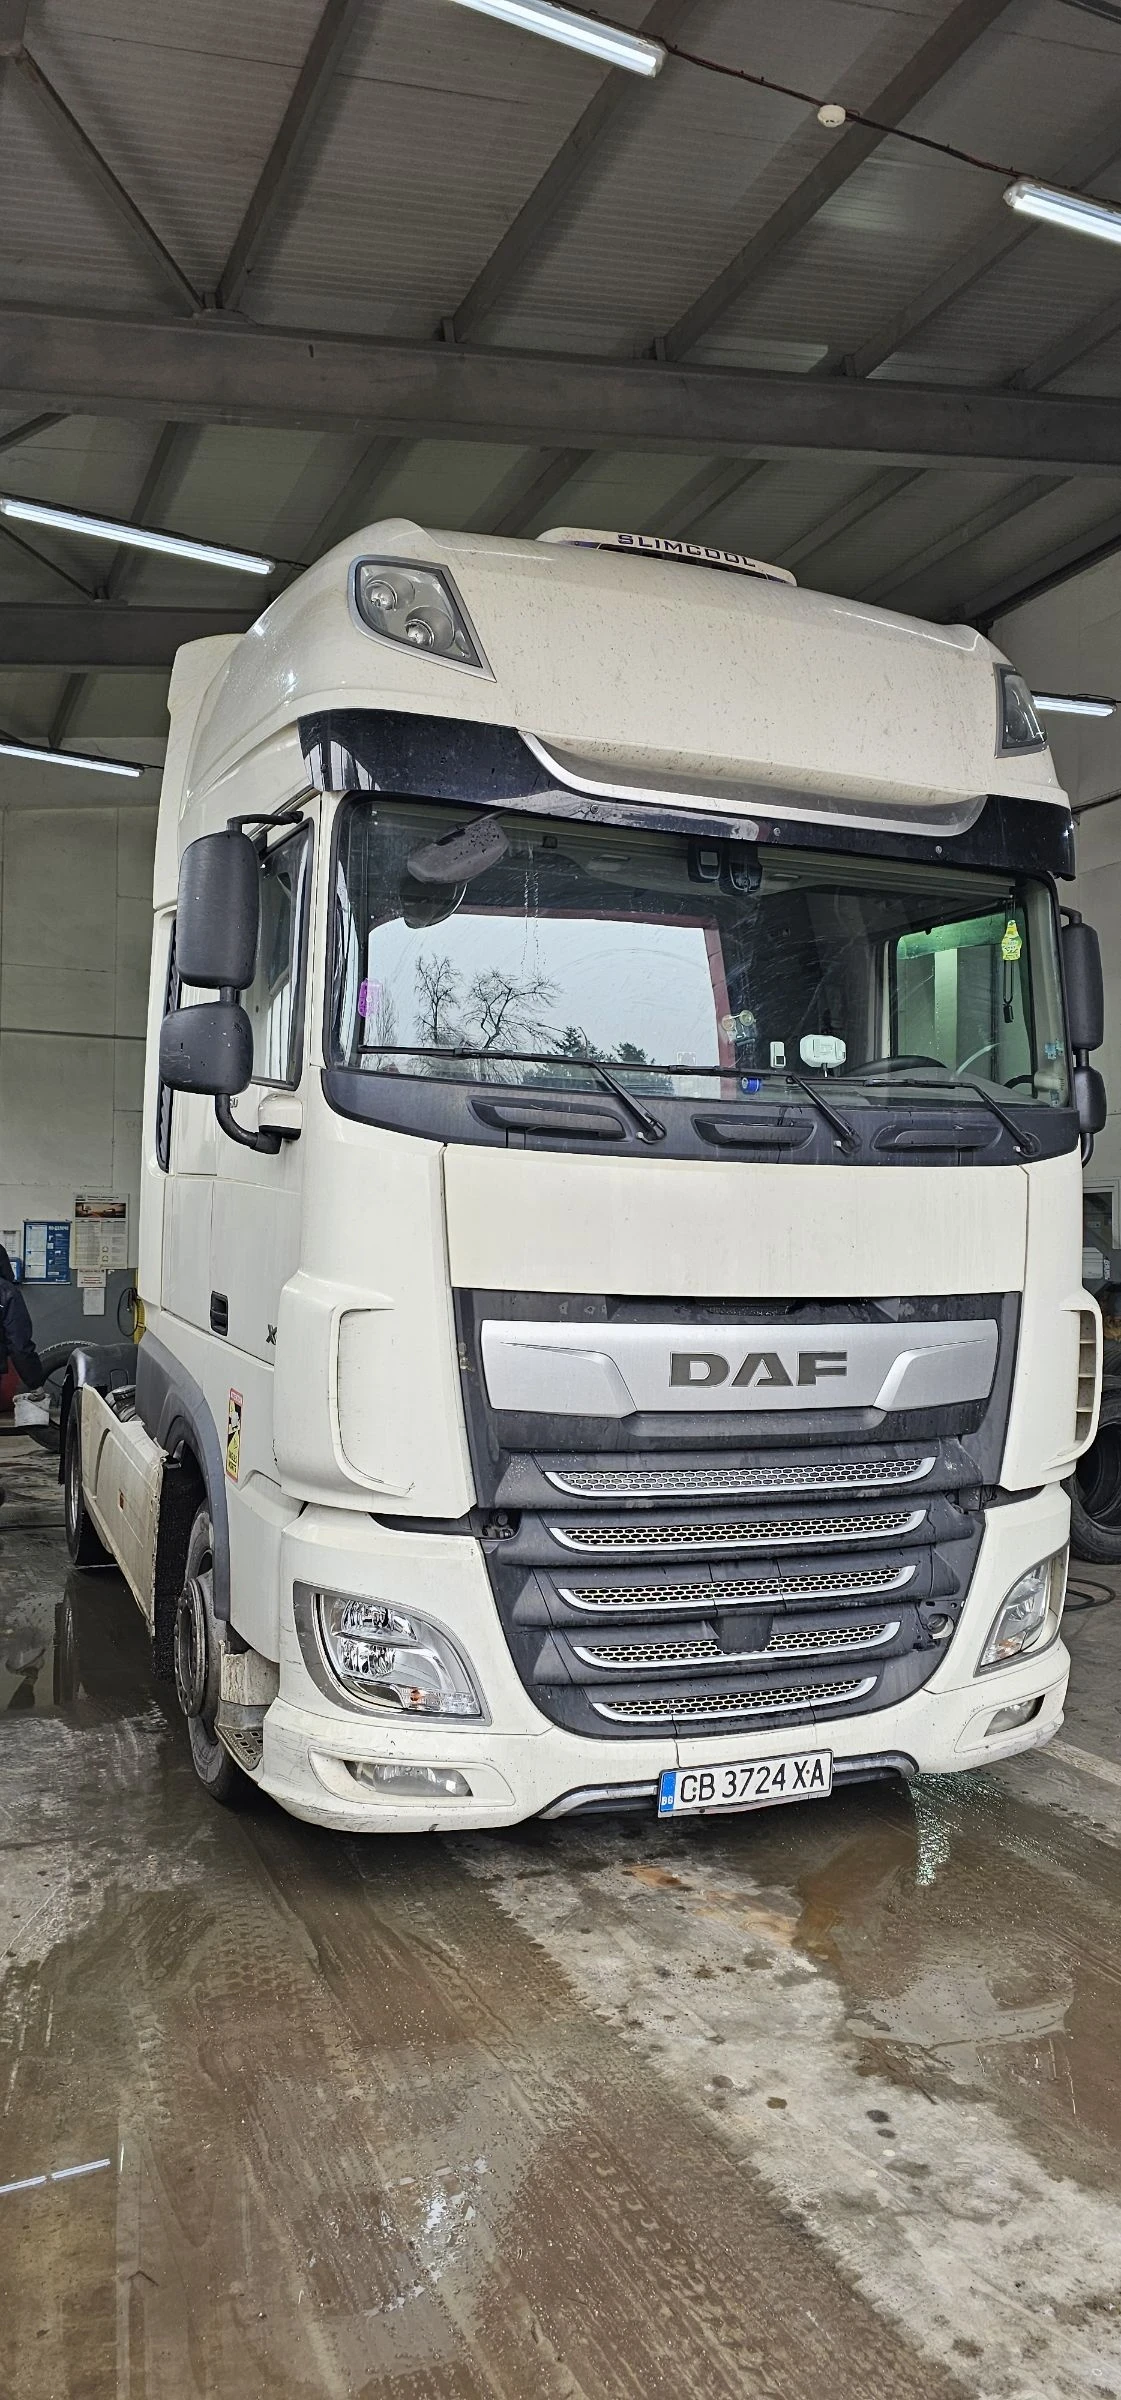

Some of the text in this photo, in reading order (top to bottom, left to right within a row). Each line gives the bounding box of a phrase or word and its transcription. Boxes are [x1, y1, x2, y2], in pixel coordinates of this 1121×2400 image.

[618, 534, 756, 567] SLIMCOOL
[669, 1351, 848, 1387] DAF
[680, 1758, 825, 1802] CB 3724 XA
